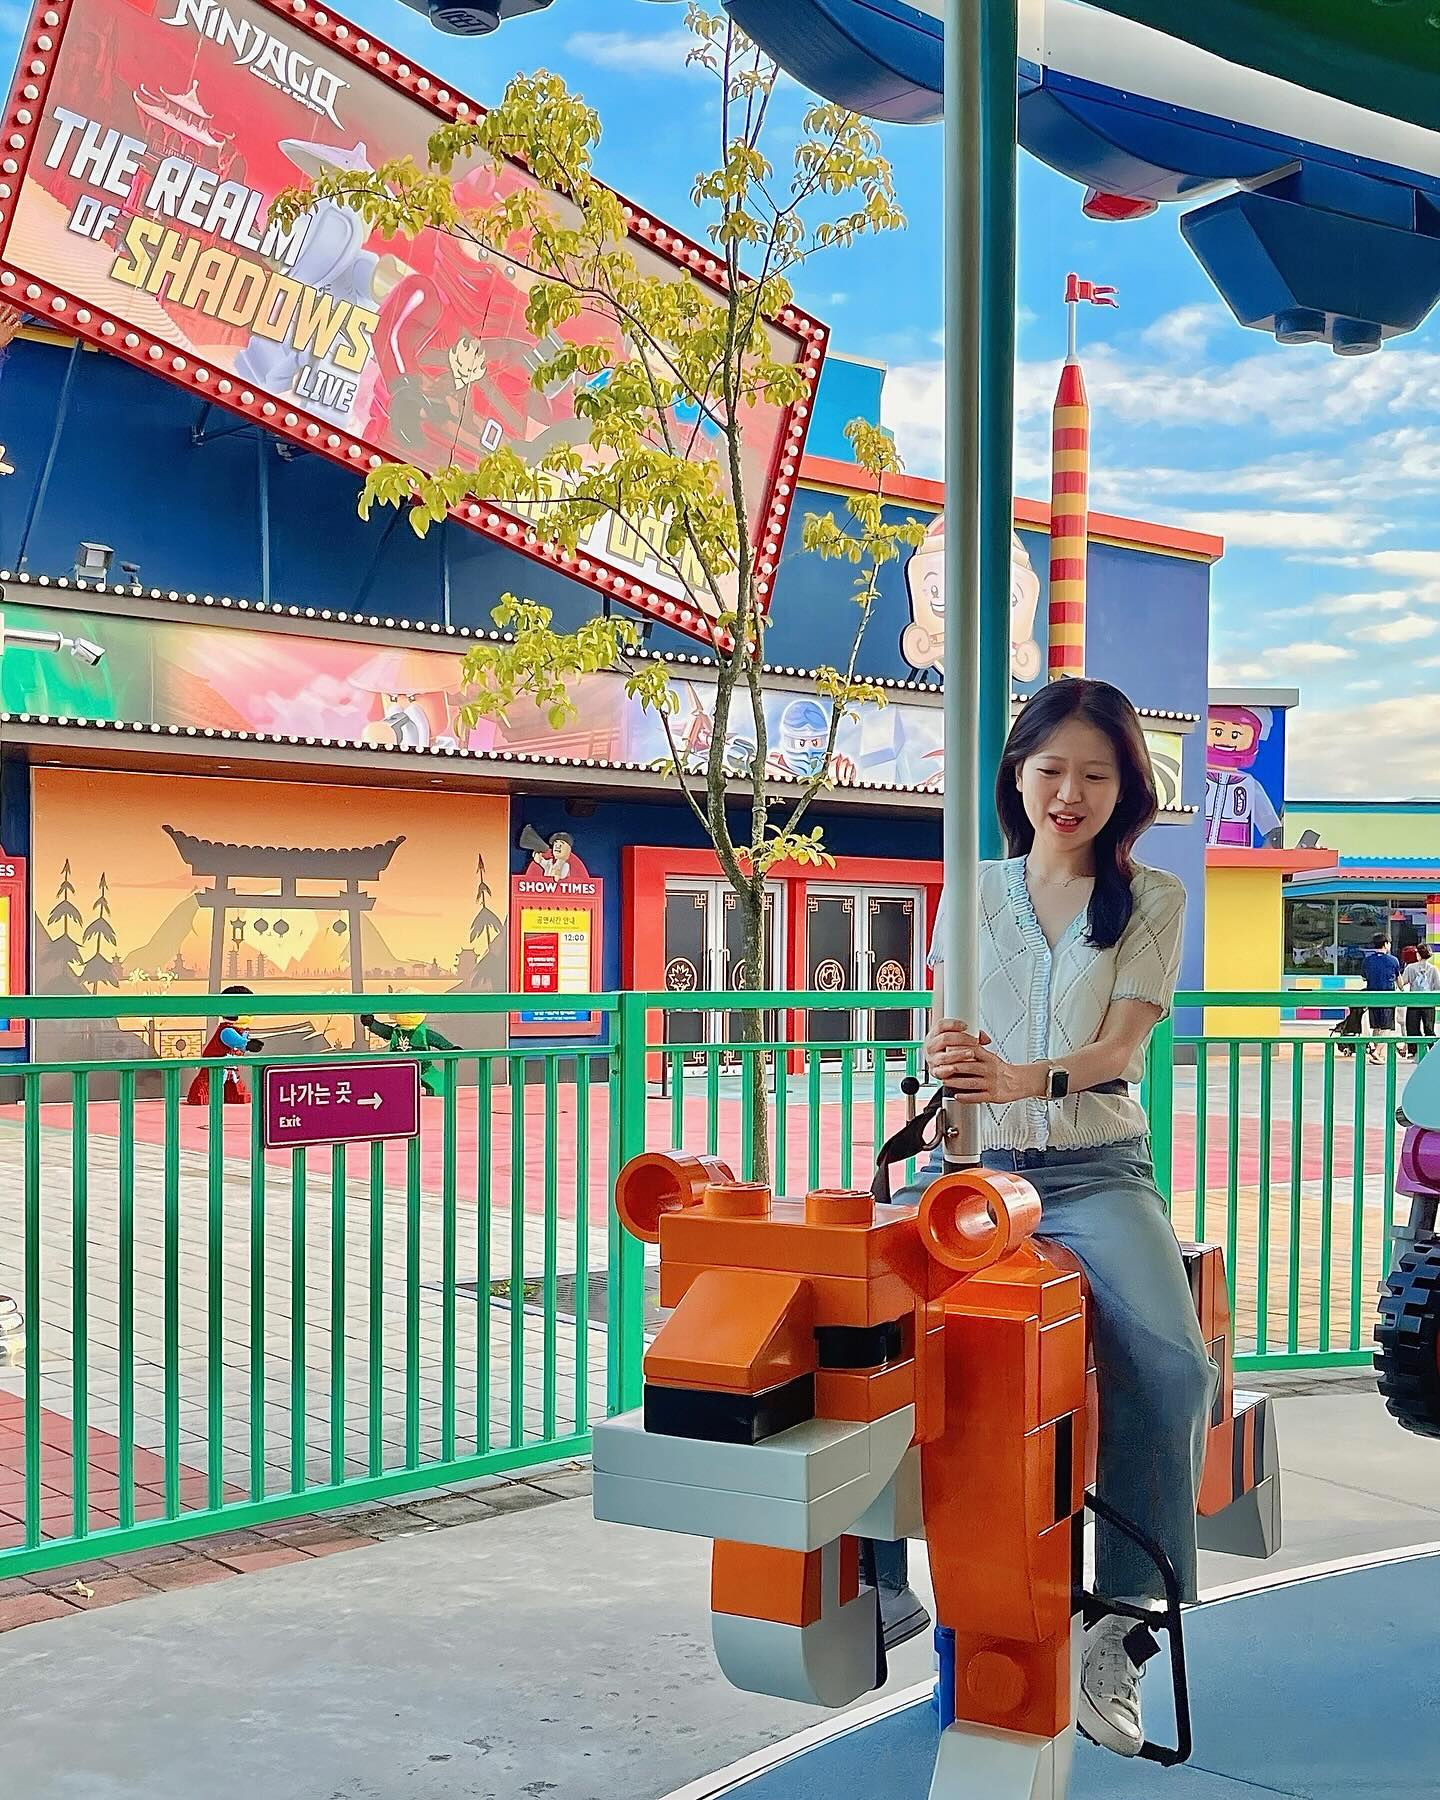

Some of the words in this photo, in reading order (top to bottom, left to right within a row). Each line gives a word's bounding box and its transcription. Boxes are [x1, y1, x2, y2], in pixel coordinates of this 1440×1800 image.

[160, 0, 347, 131] NINJAGO
[44, 106, 147, 198] THE
[145, 155, 313, 268] REALM
[68, 195, 119, 240] OF
[110, 214, 380, 373] SHADOWS
[295, 365, 357, 413] LIVE
[519, 881, 557, 893] SHOW
[560, 882, 596, 895] TIMES
[564, 934, 585, 942] 12:00
[279, 1083, 331, 1107] 나가는
[335, 1081, 352, 1104] 곳
[279, 1115, 301, 1128] Exit
